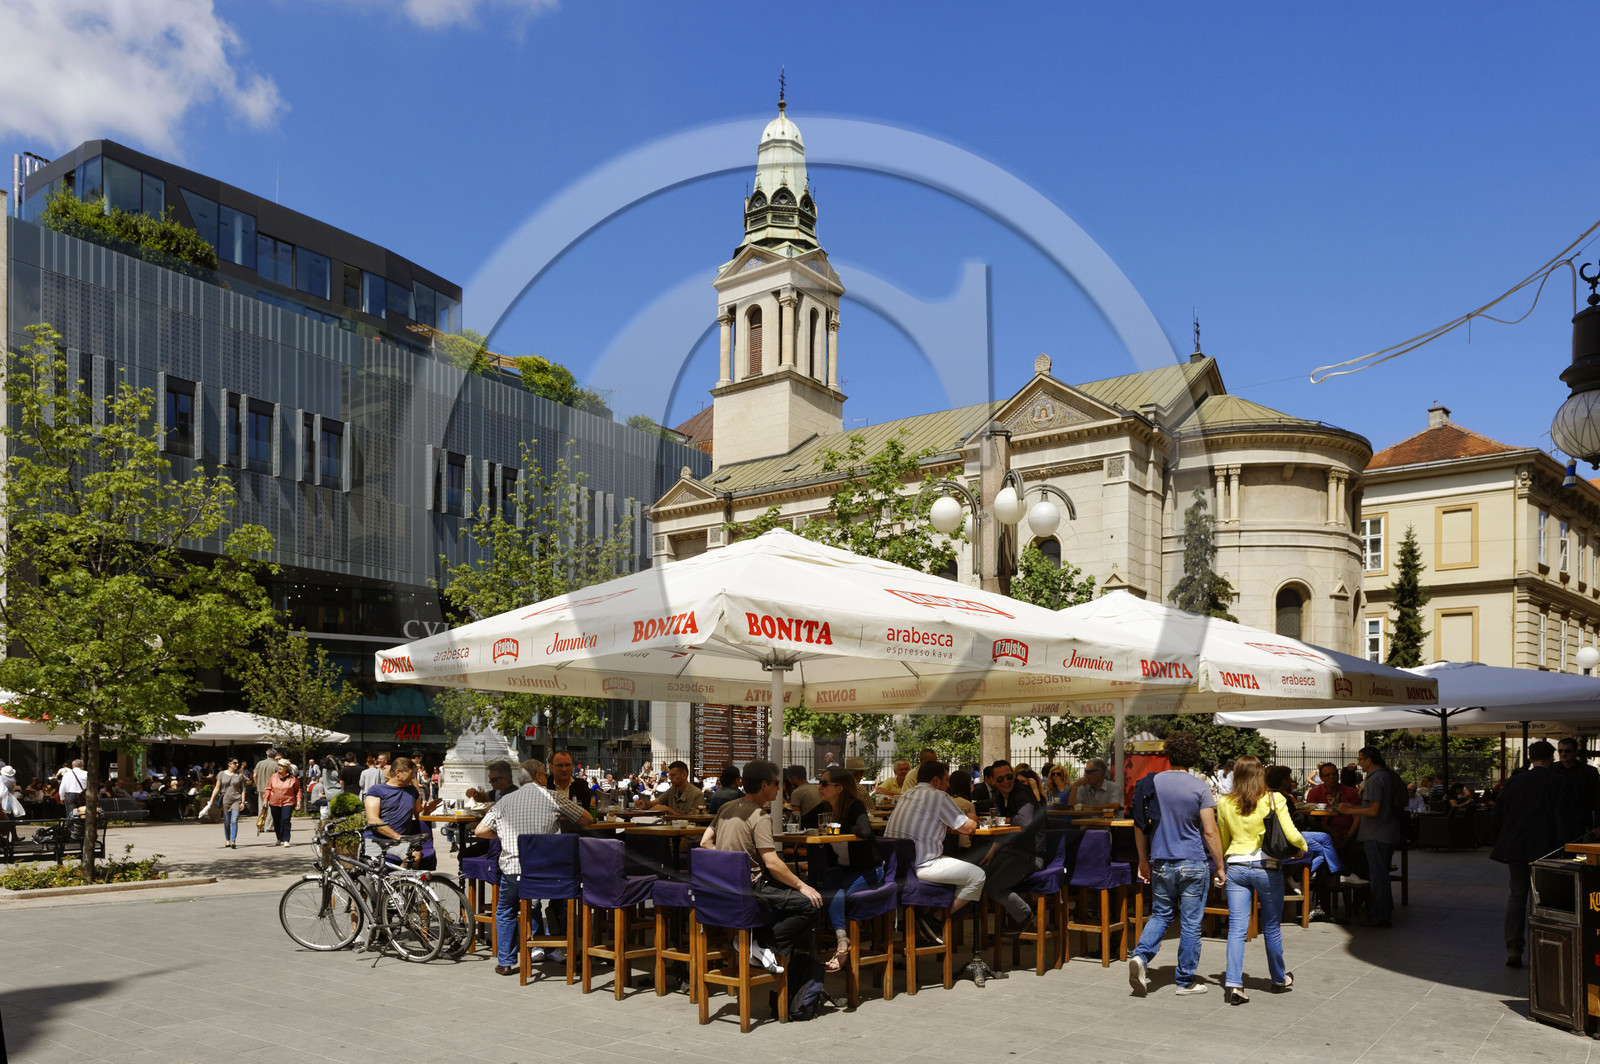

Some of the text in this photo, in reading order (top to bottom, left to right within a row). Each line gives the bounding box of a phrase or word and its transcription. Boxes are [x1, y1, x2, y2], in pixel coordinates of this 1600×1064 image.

[631, 611, 698, 643] BONITA
[745, 612, 833, 645] BONITA
[546, 632, 598, 655] Jamnica
[886, 627, 953, 647] arabesca
[433, 647, 470, 662] arabesca
[886, 646, 953, 659] espresso kava
[995, 640, 1026, 659] Ožujsko
[381, 656, 414, 674] BONITA
[1063, 649, 1114, 671] Jamnica
[1140, 659, 1193, 679] BONITA
[1219, 671, 1260, 690] BONITA
[1281, 674, 1316, 686] arabesca
[1406, 687, 1436, 700] BONITA
